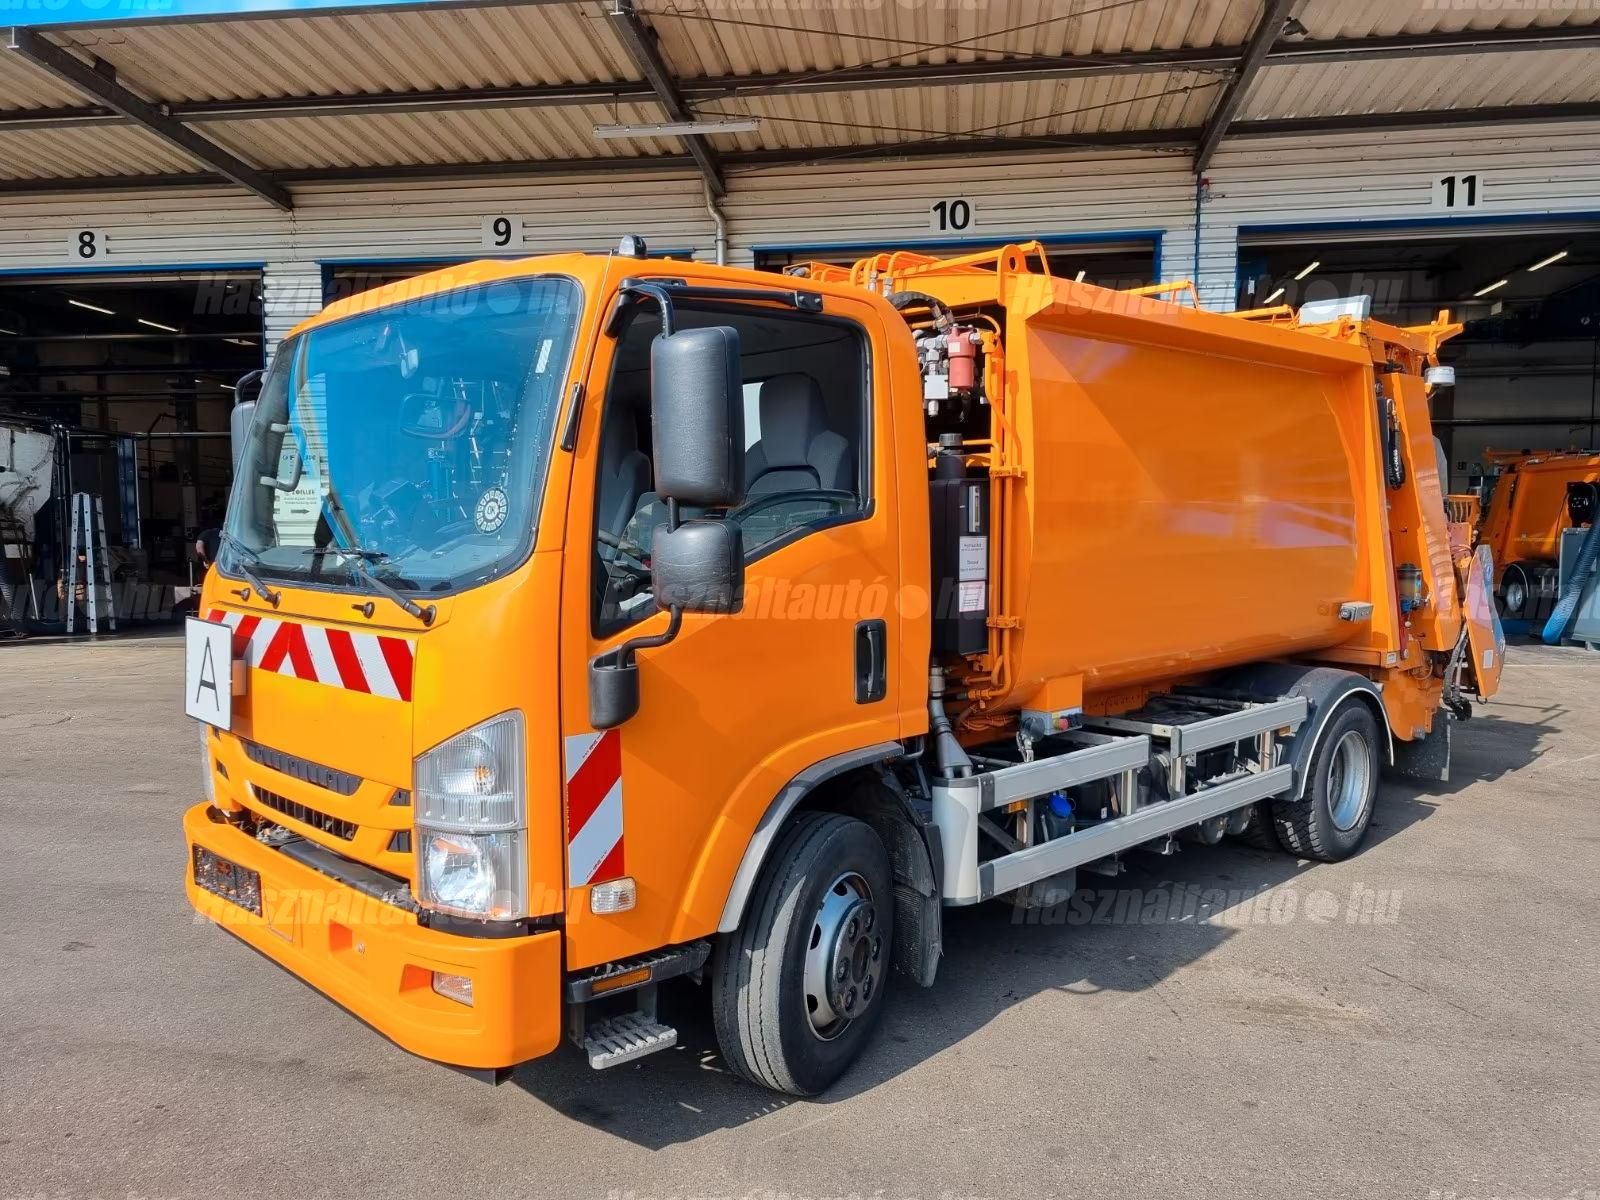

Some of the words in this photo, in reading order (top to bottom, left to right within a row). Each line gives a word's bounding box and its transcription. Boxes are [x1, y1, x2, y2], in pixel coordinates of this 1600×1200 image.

[1440, 174, 1477, 207] 11
[931, 199, 970, 230] 10
[78, 231, 97, 258] 8
[493, 217, 512, 247] 9
[195, 636, 220, 712] A
